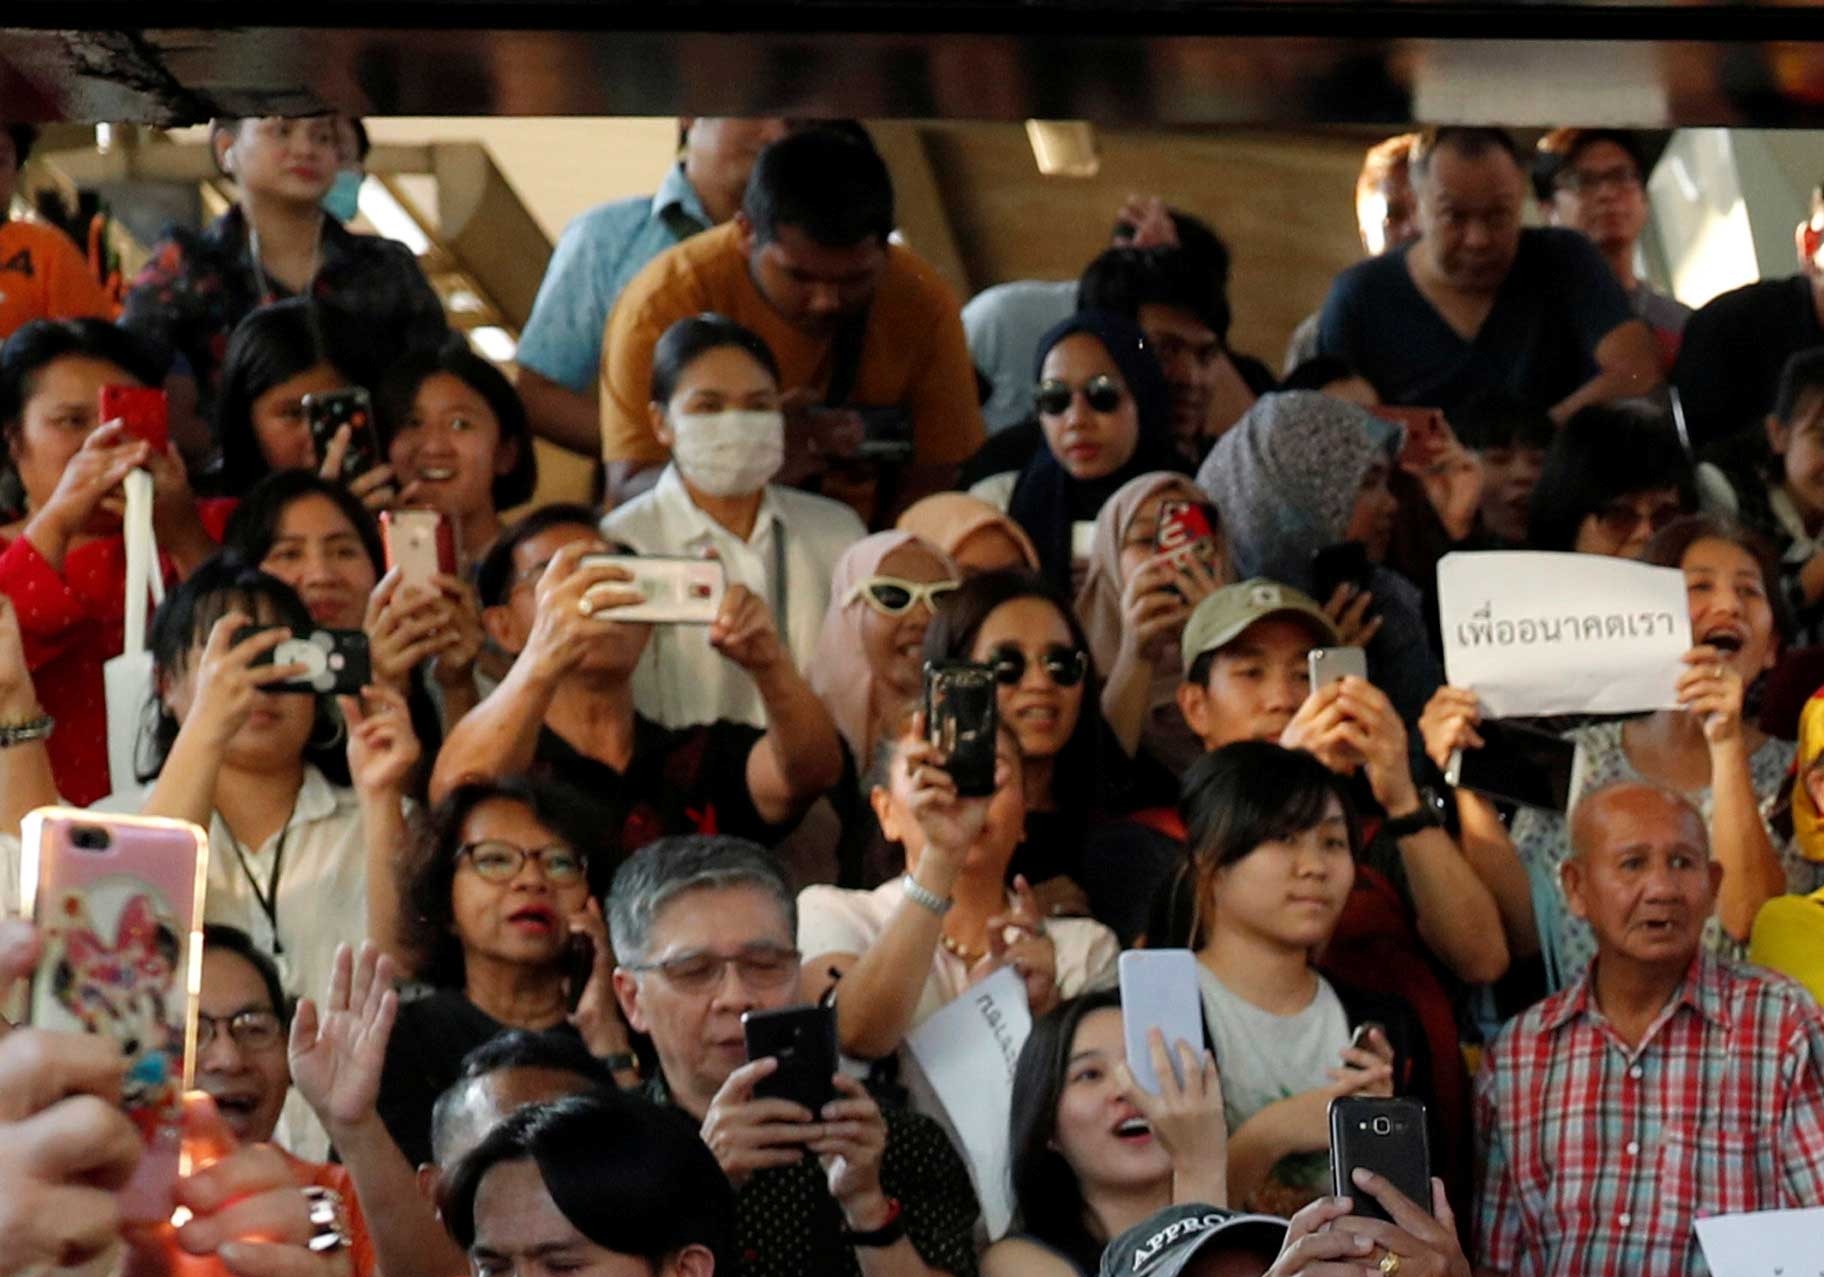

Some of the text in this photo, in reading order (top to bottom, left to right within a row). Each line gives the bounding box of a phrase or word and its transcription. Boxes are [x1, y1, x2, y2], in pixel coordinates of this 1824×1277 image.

[1456, 600, 1676, 648] เพื่ออนาคตเรา
[1132, 1213, 1235, 1272] APPRO
